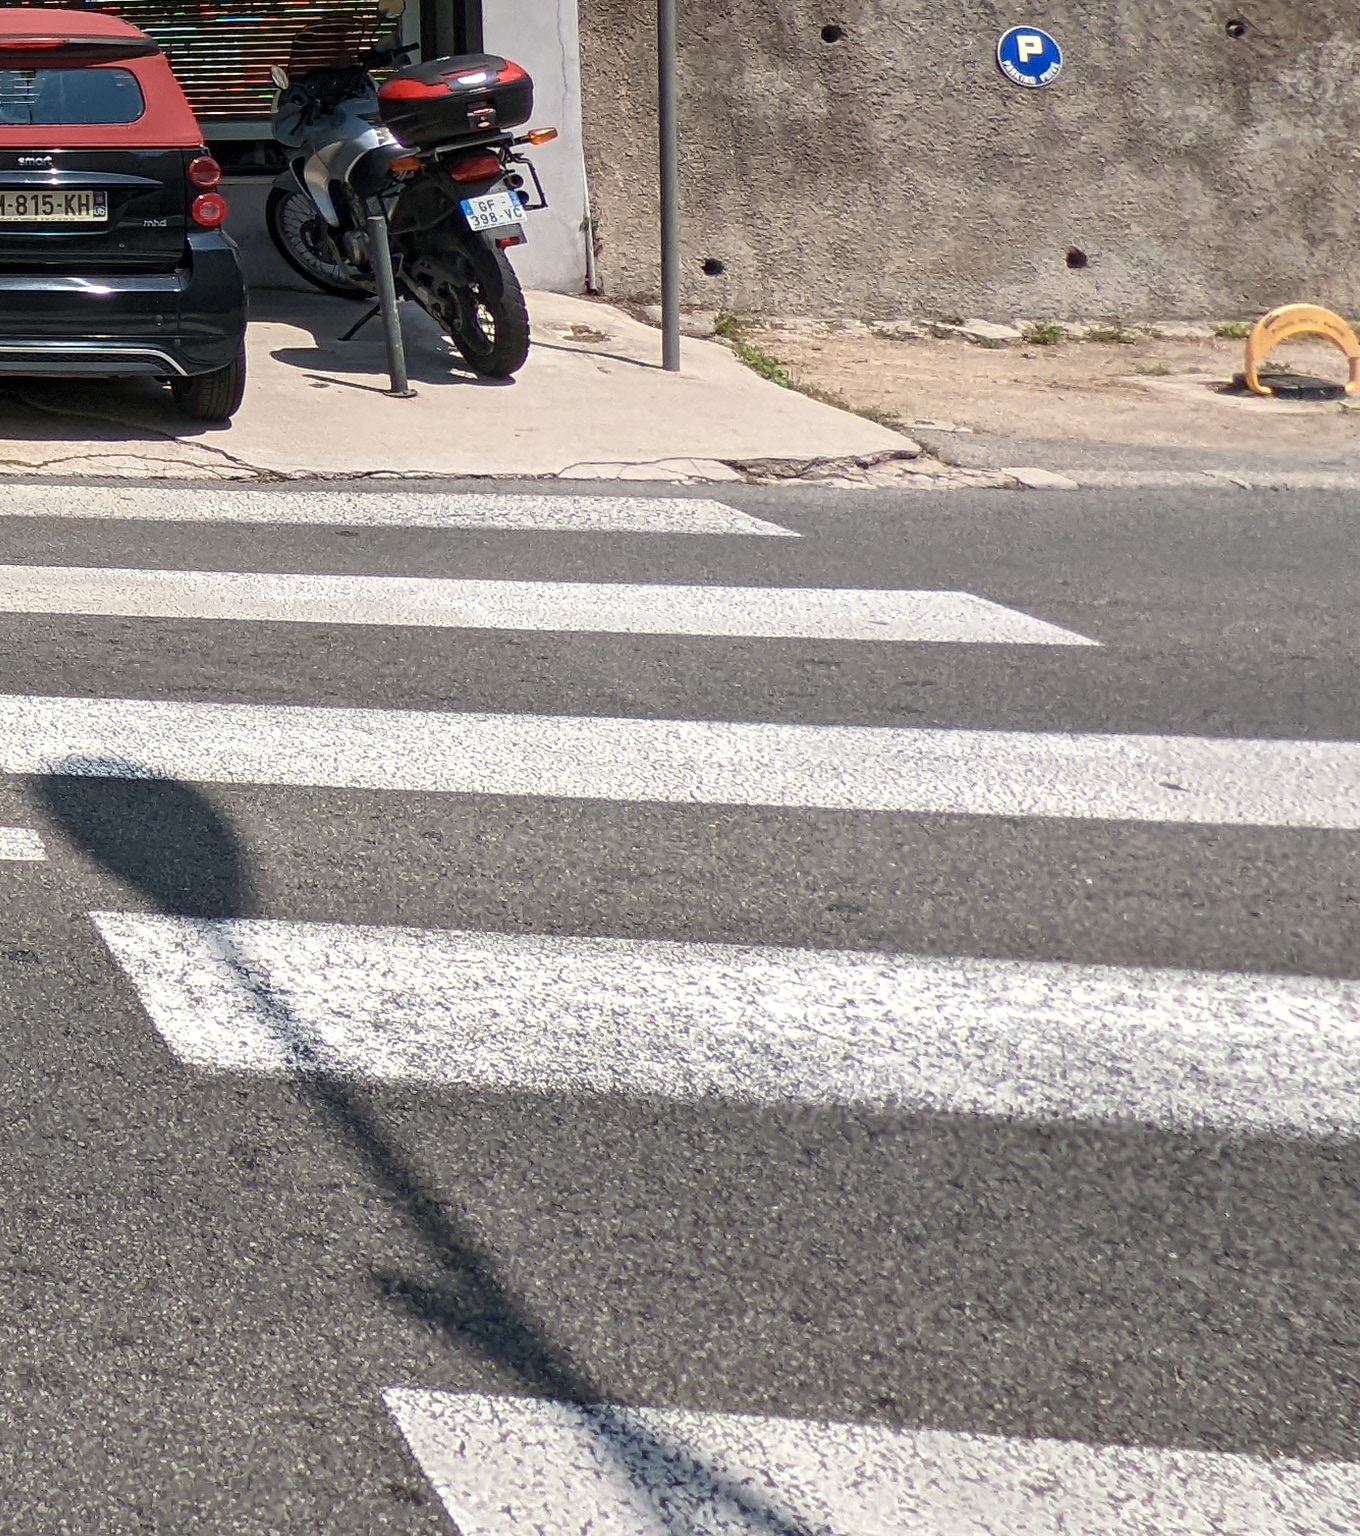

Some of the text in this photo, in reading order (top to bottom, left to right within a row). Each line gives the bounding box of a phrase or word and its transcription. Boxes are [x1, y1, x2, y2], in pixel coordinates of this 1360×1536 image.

[1016, 35, 1043, 63] P
[18, 157, 53, 166] smart
[143, 217, 167, 227] mhd
